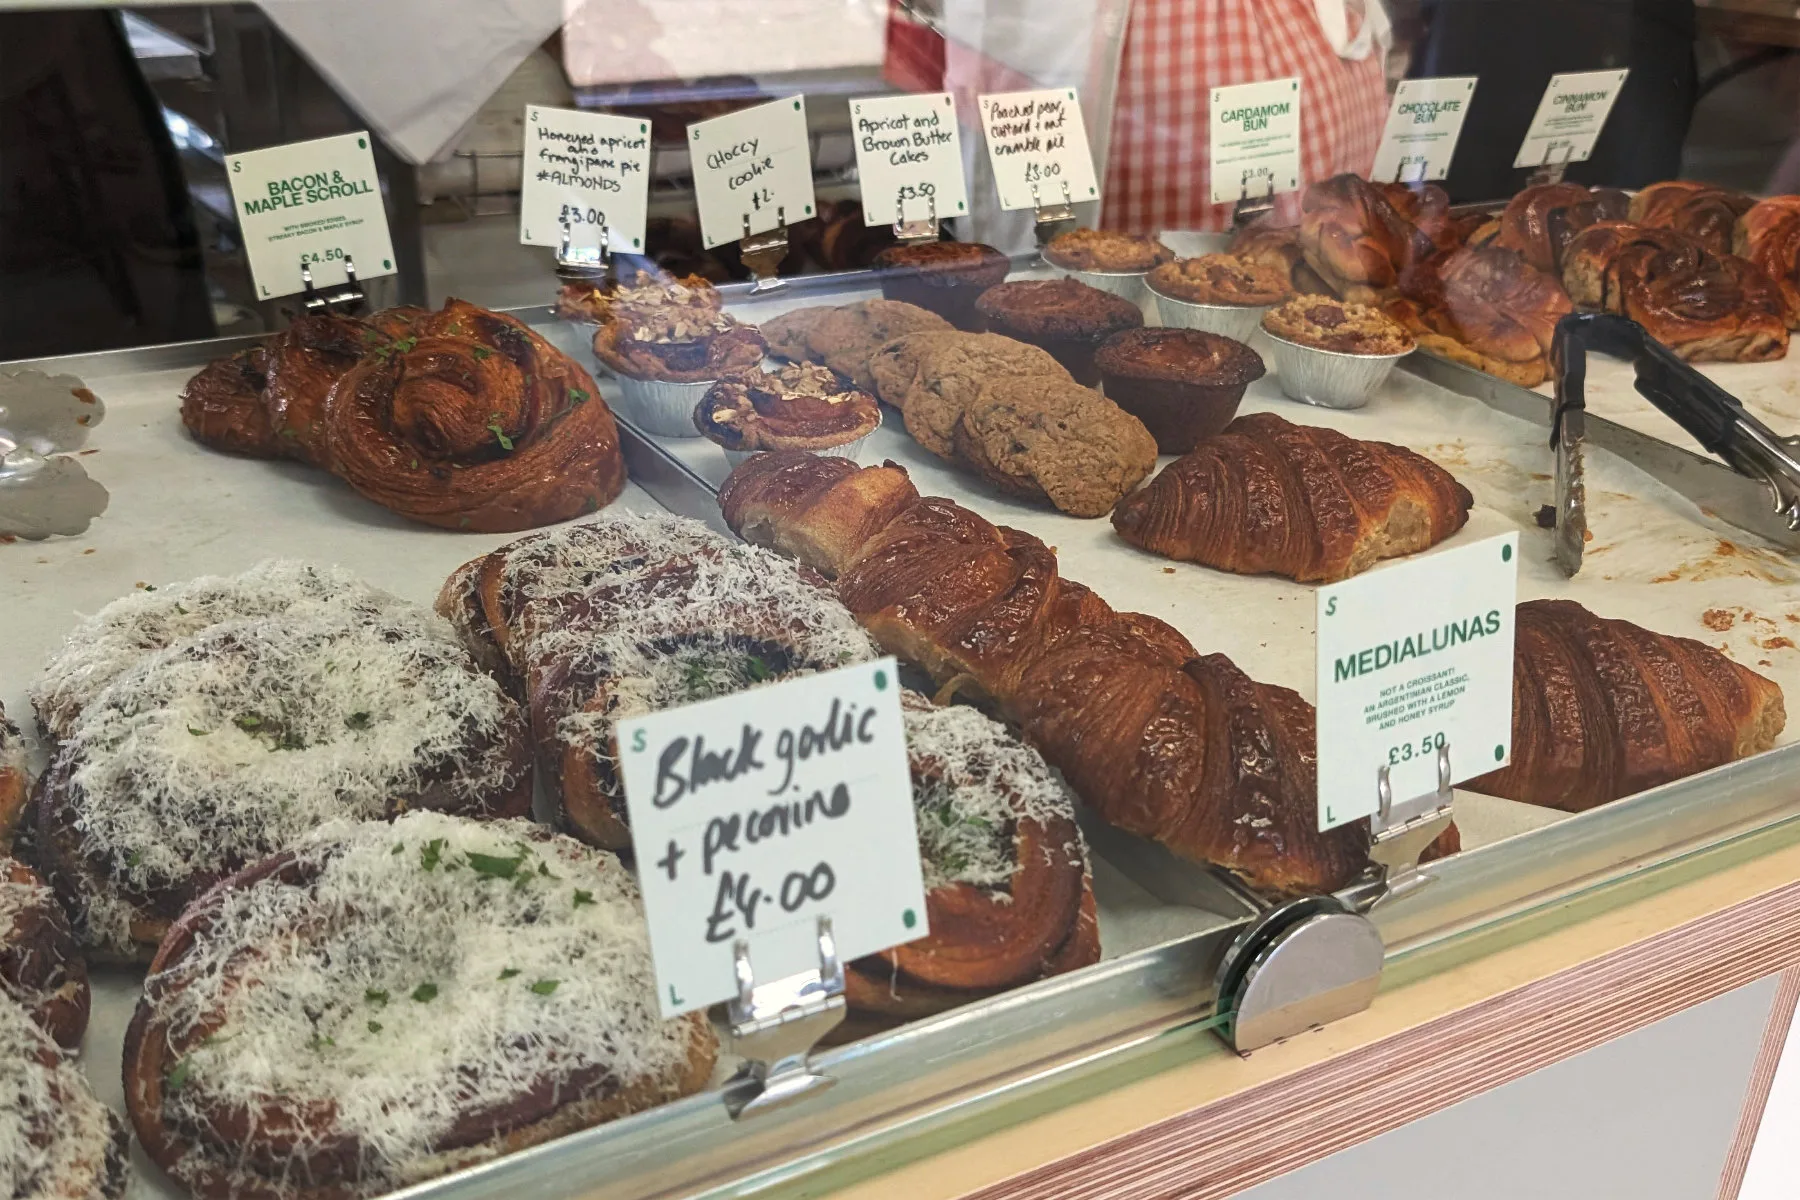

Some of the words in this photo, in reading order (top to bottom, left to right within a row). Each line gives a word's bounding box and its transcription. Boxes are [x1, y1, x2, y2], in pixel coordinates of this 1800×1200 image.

[1398, 101, 1462, 115] CHOCOLATE
[1552, 91, 1608, 105] CINNAMON
[1564, 102, 1587, 113] BUN
[531, 112, 539, 121] S
[855, 105, 861, 115] S
[1221, 102, 1290, 123] CARDAMOM
[1413, 112, 1437, 124] BUN
[859, 114, 910, 135] Apricot
[913, 110, 940, 128] and
[990, 118, 1030, 138] custard
[1243, 118, 1267, 132] BUN
[538, 127, 595, 150] Honeyed
[600, 136, 646, 153] apricot
[694, 130, 700, 140] S
[862, 136, 910, 152] Brown
[912, 129, 952, 147] Butter
[995, 136, 1041, 156] crumble
[1046, 132, 1065, 153] pie
[233, 161, 242, 172] S
[539, 148, 615, 175] frangipane
[621, 160, 641, 177] pie
[889, 151, 929, 166] Cakes
[268, 173, 328, 196] BACON
[333, 170, 344, 183] &
[898, 182, 936, 200] £3.50
[244, 192, 304, 215] MAPLE
[306, 180, 374, 203] SCROLL
[558, 205, 606, 226] £3.00
[868, 212, 875, 222] L
[525, 229, 532, 239] L
[707, 236, 715, 245] L
[301, 247, 344, 265] £4.50
[262, 286, 270, 296] L
[1325, 596, 1337, 616] S
[1334, 610, 1501, 683] MEDIALUNAS
[1380, 685, 1397, 698] NOT
[1398, 684, 1404, 692] A
[1406, 667, 1455, 689] CROISSANT!
[1364, 704, 1375, 714] AN
[1377, 686, 1432, 709] ARGENTINIAN
[1366, 705, 1405, 725] BRUSHED
[1407, 698, 1427, 710] WITH
[1429, 695, 1435, 703] A
[1437, 685, 1466, 701] LEMON
[1379, 719, 1396, 731] AND
[1398, 709, 1426, 724] HONEY
[1428, 699, 1456, 714] SYRUP
[631, 728, 647, 753] S
[1388, 732, 1446, 766] £3.50
[653, 723, 764, 809] Black
[767, 697, 877, 796] garlic
[1326, 805, 1336, 823] L
[657, 840, 686, 881] +
[702, 782, 851, 875] pecorino
[705, 861, 836, 944] £4.00
[669, 984, 685, 1006] L
